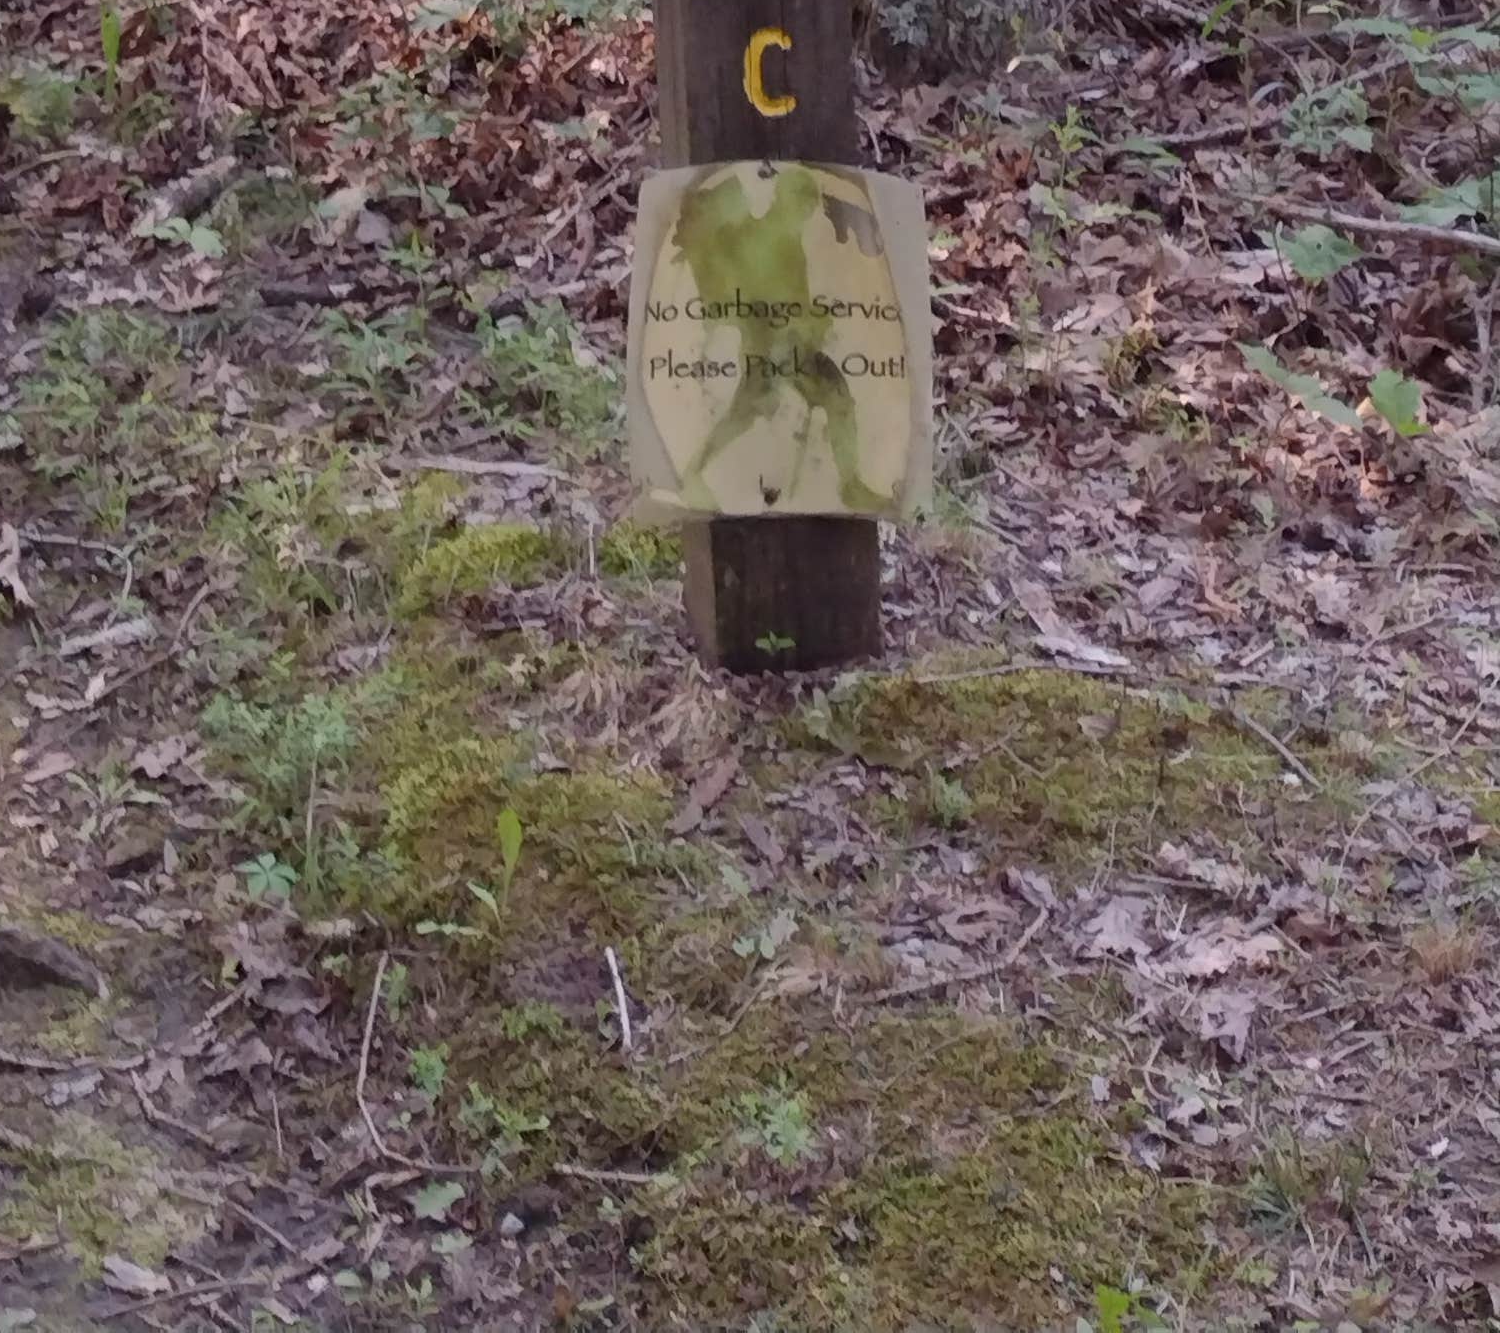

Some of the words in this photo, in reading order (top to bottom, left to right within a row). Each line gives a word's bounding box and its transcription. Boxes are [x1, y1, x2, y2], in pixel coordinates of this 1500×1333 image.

[743, 27, 796, 117] C
[644, 301, 679, 324] No
[685, 287, 802, 328] Garbage
[810, 294, 902, 322] Servic
[650, 348, 737, 381] Please
[745, 345, 808, 379] Pack
[841, 353, 905, 379] Out!
